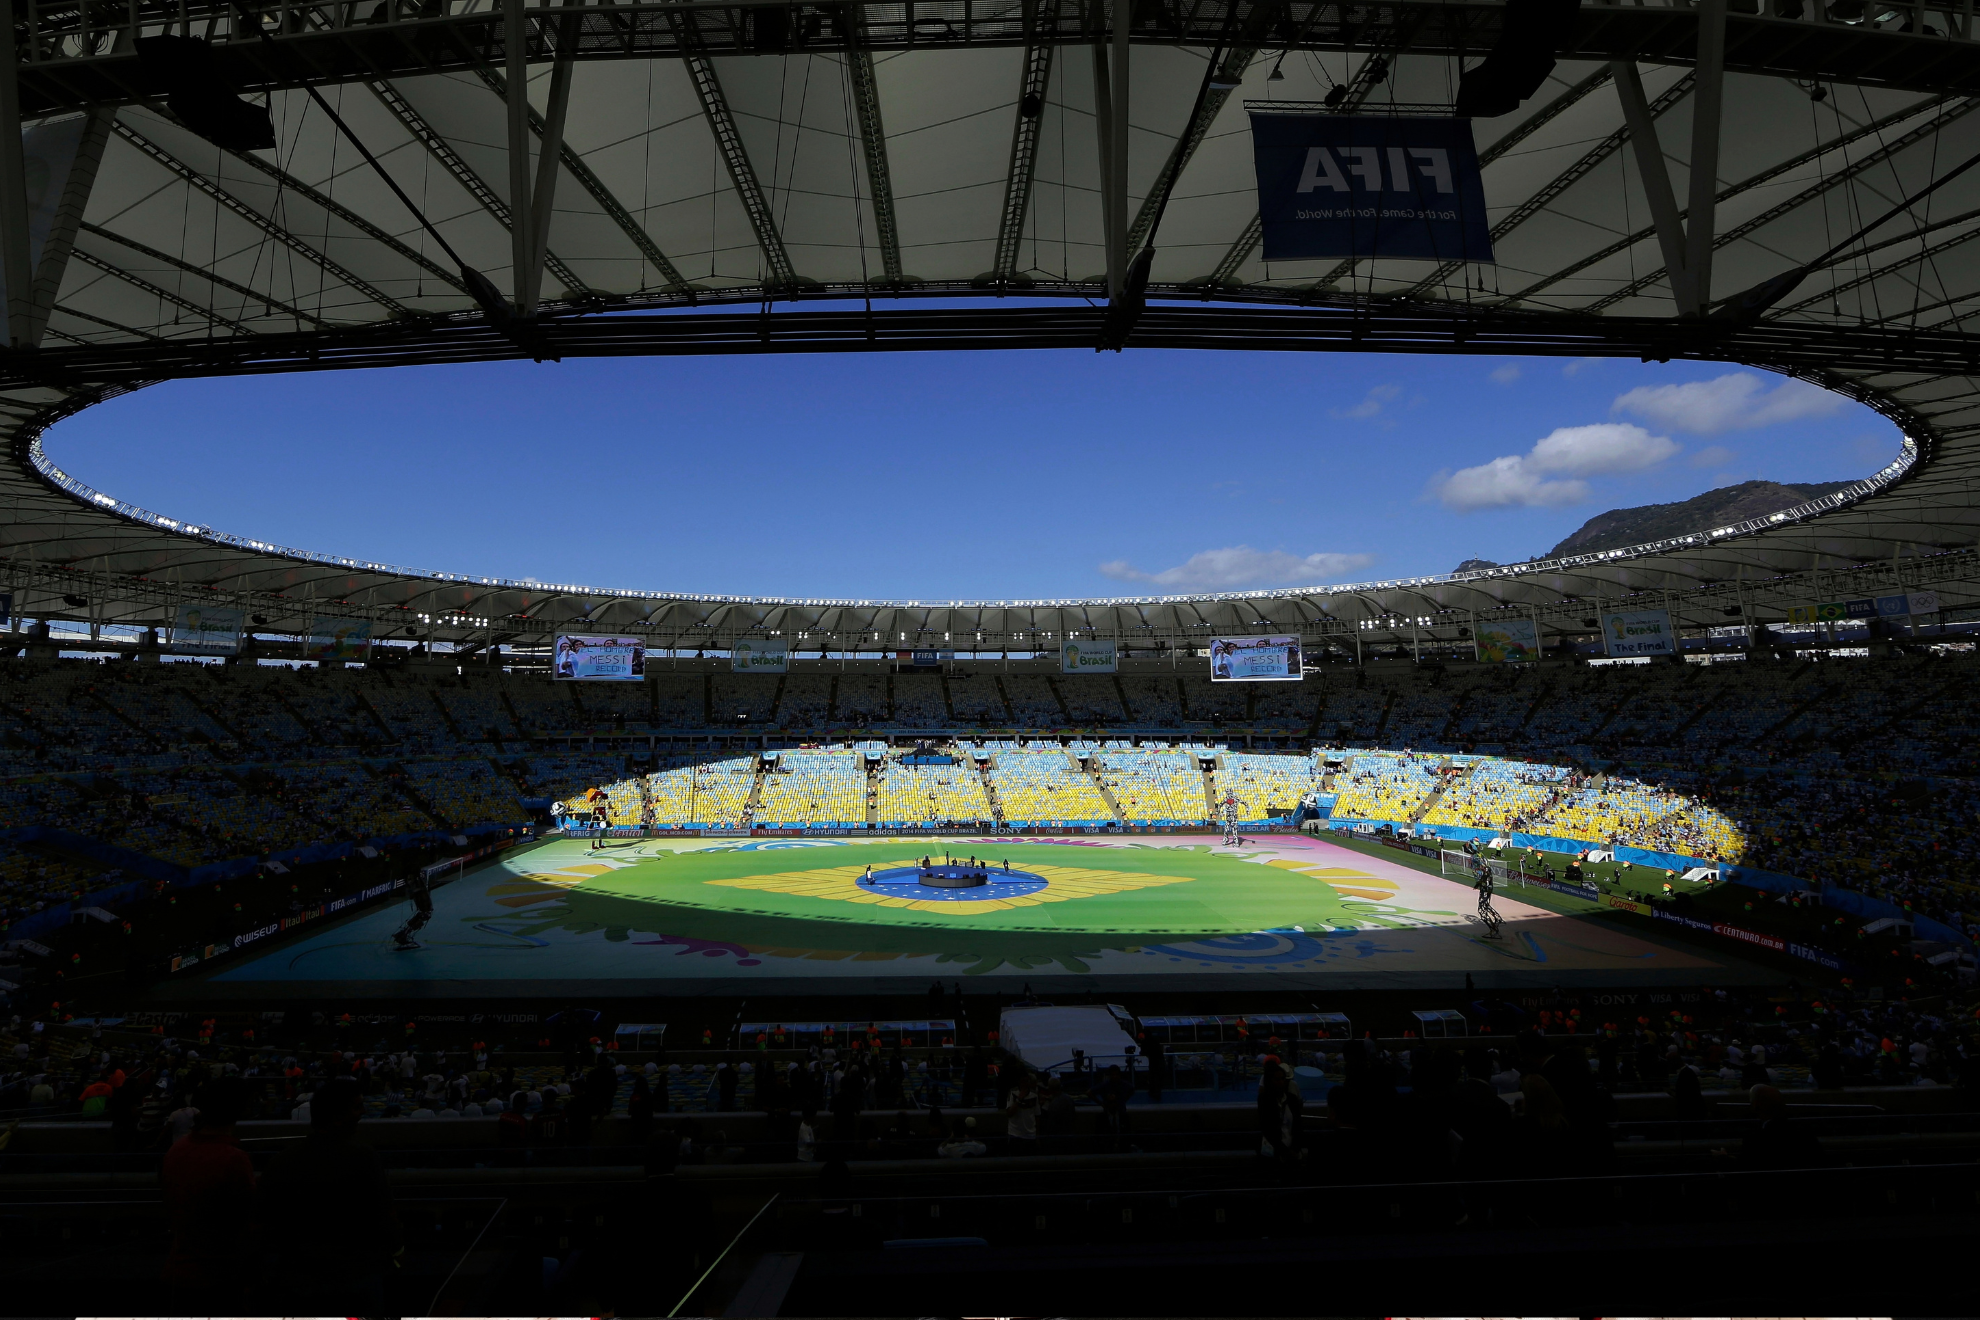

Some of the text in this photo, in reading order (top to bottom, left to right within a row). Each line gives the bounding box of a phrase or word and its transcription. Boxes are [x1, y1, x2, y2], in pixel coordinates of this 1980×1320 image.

[1850, 603, 1871, 612] FIFA
[200, 621, 233, 632] Brasil
[1626, 624, 1662, 636] Brasil
[1614, 641, 1667, 652] The Final
[751, 655, 784, 666] Brasil
[1080, 655, 1113, 666] Brasil
[1411, 845, 1422, 855] VISA
[1425, 849, 1437, 858] VISA
[1551, 882, 1561, 890] FIFA
[1562, 886, 1579, 895] FOOTBALL
[1609, 896, 1638, 912] Garoto
[305, 907, 320, 921] Itaú
[285, 914, 301, 929] Itaú
[1660, 911, 1712, 930] Liberty Seguros
[1523, 996, 1538, 1008] Fly
[1649, 994, 1673, 1003] VISA
[489, 1013, 538, 1023] YUNDAI
[542, 1120, 556, 1138] 10
